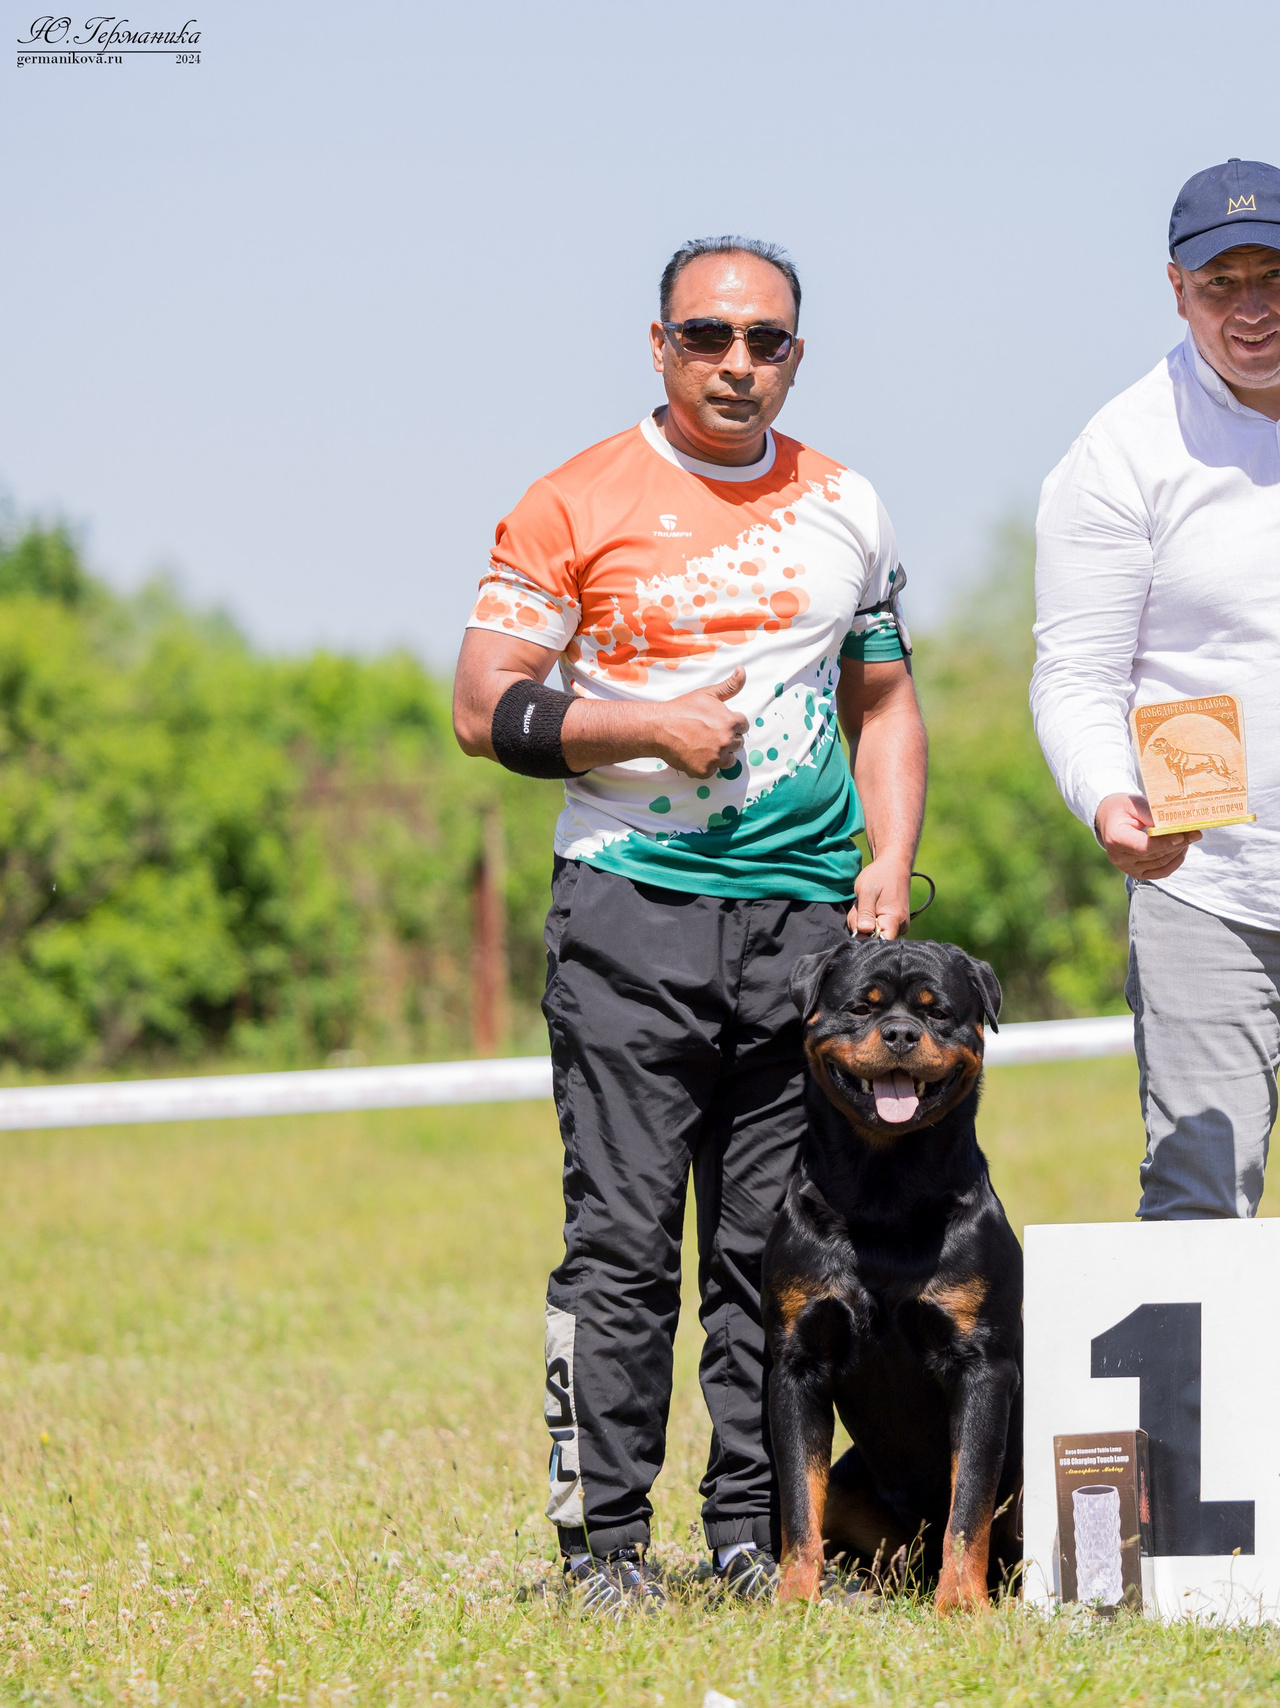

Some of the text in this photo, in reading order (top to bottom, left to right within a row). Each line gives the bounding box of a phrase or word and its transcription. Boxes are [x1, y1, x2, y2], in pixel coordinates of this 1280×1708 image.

[1157, 802, 1244, 822] Воронежские встречи
[1091, 1302, 1255, 1556] 1
[1060, 1455, 1129, 1466] USB Charging Touch Lamp
